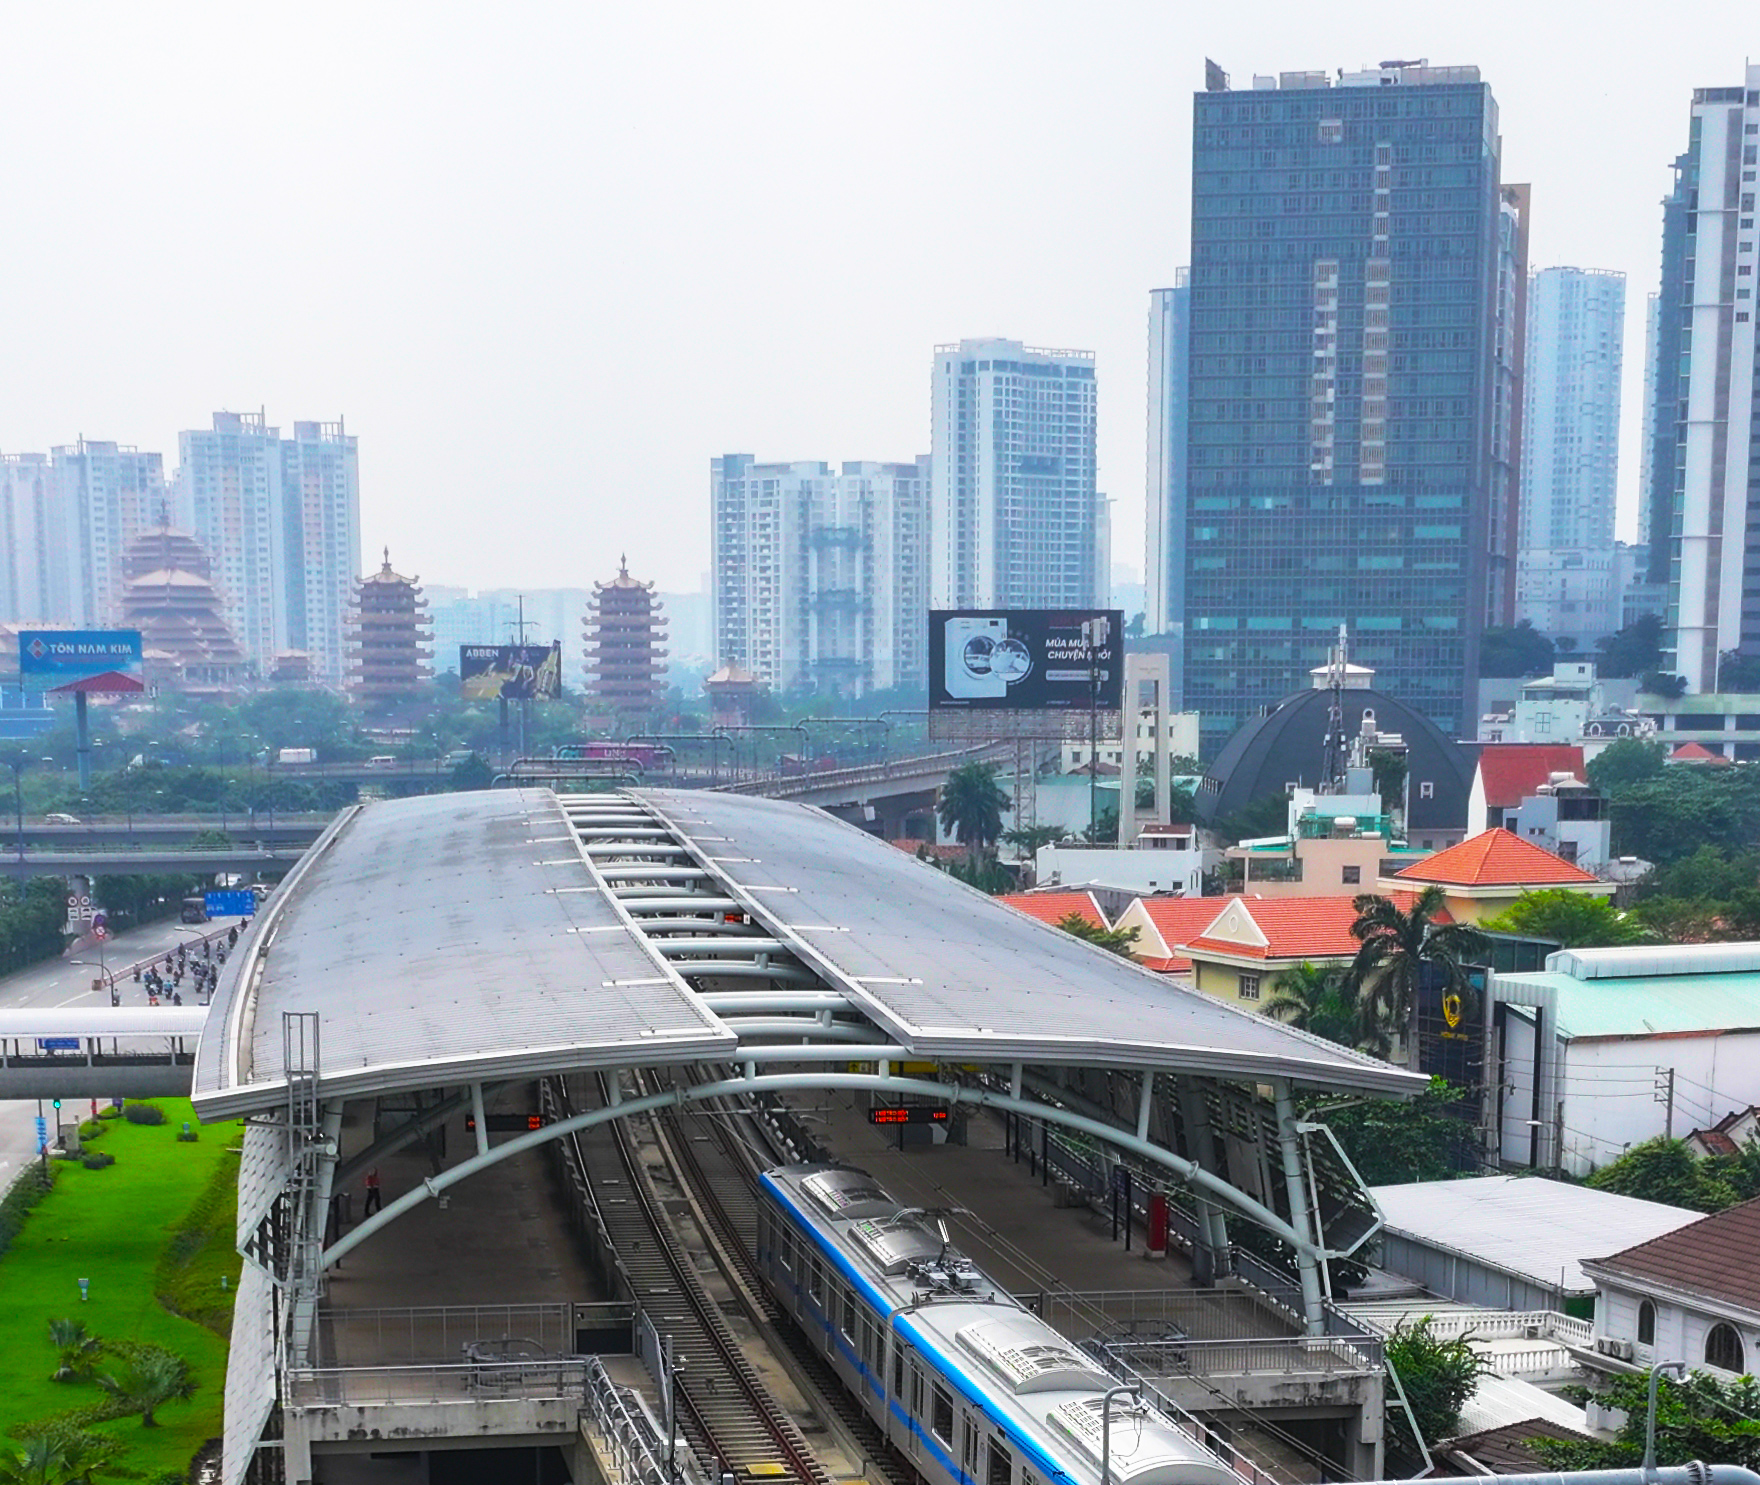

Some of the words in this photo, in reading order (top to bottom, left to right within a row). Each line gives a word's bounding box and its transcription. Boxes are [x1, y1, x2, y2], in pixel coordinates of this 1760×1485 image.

[49, 642, 75, 654] TÔN
[78, 644, 107, 654] NAM
[110, 644, 133, 655] KIM
